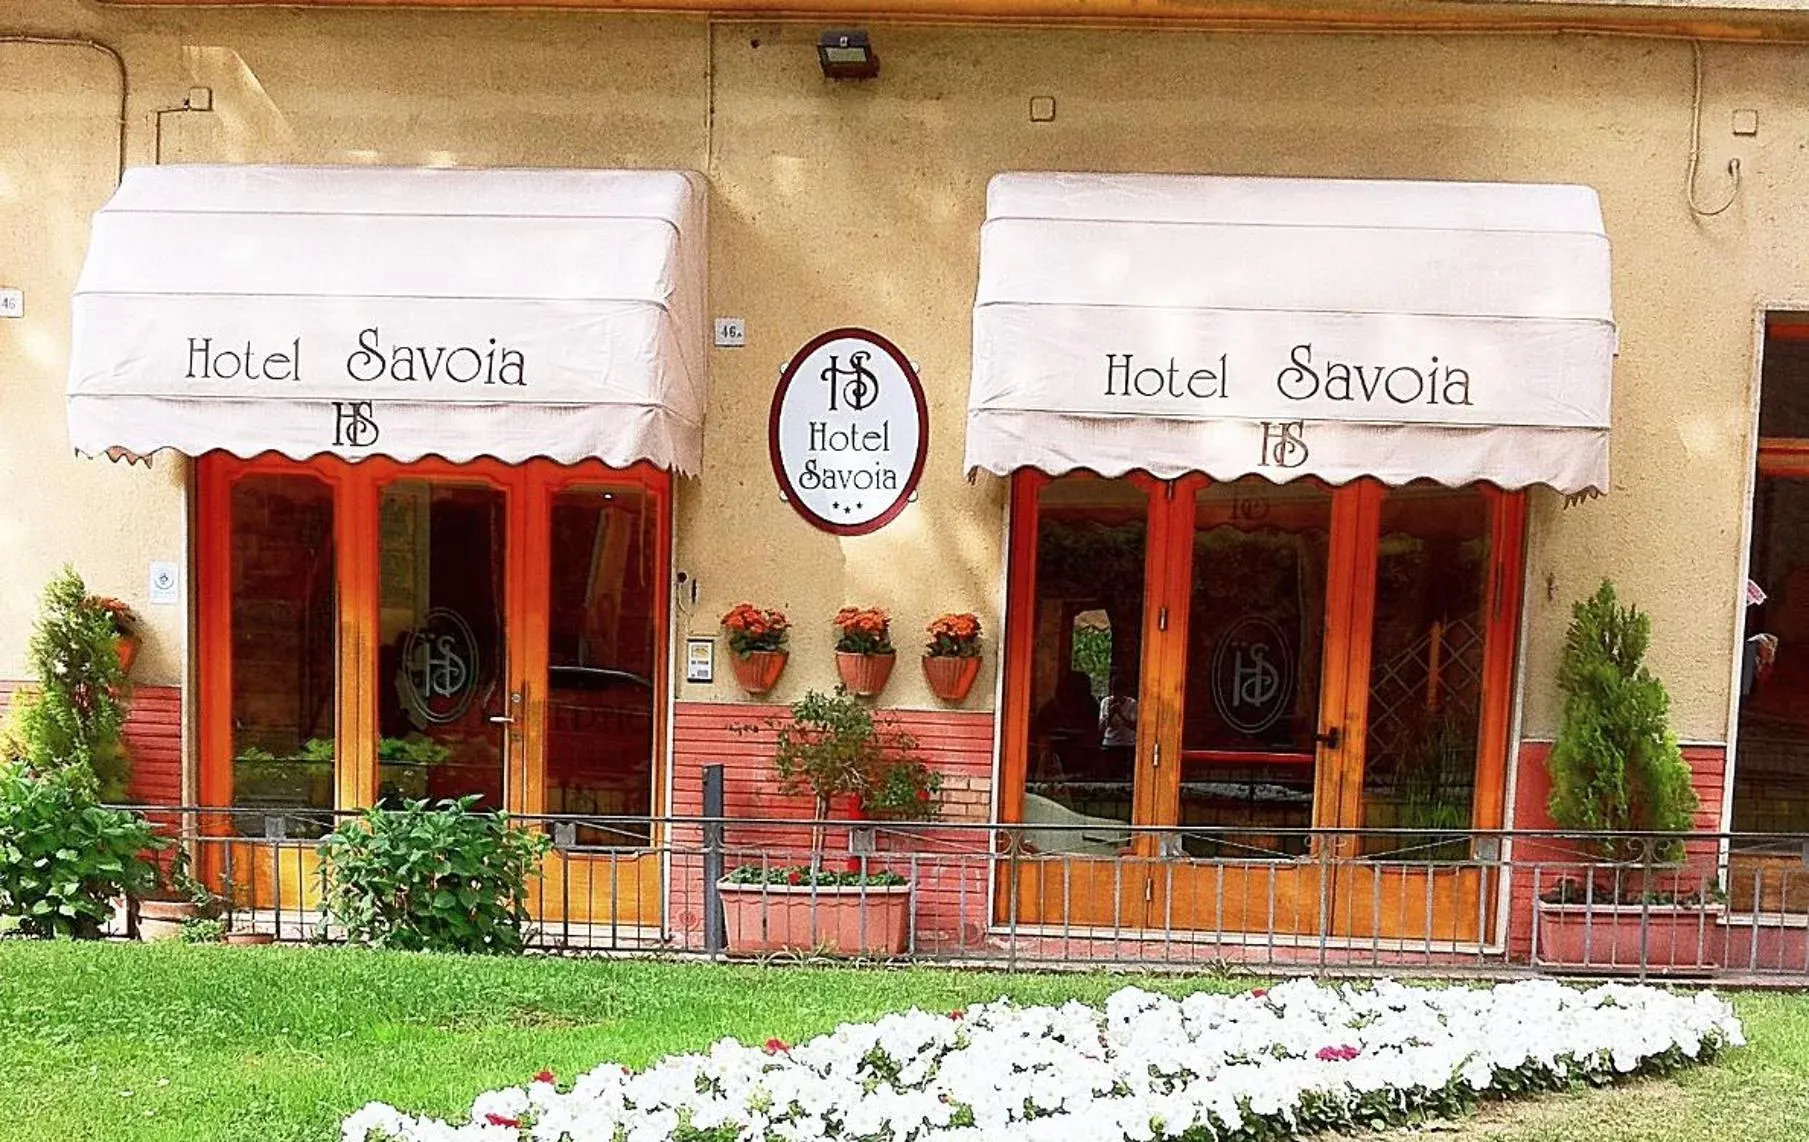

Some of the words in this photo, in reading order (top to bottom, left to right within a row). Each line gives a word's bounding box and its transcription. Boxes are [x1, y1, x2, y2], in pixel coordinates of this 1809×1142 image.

[185, 337, 301, 382] Hotel
[346, 327, 527, 386] Savoia
[1104, 352, 1229, 399] Hotel
[1277, 343, 1473, 406] Savoia
[808, 419, 890, 452] Hotel
[798, 458, 897, 490] Savoia
